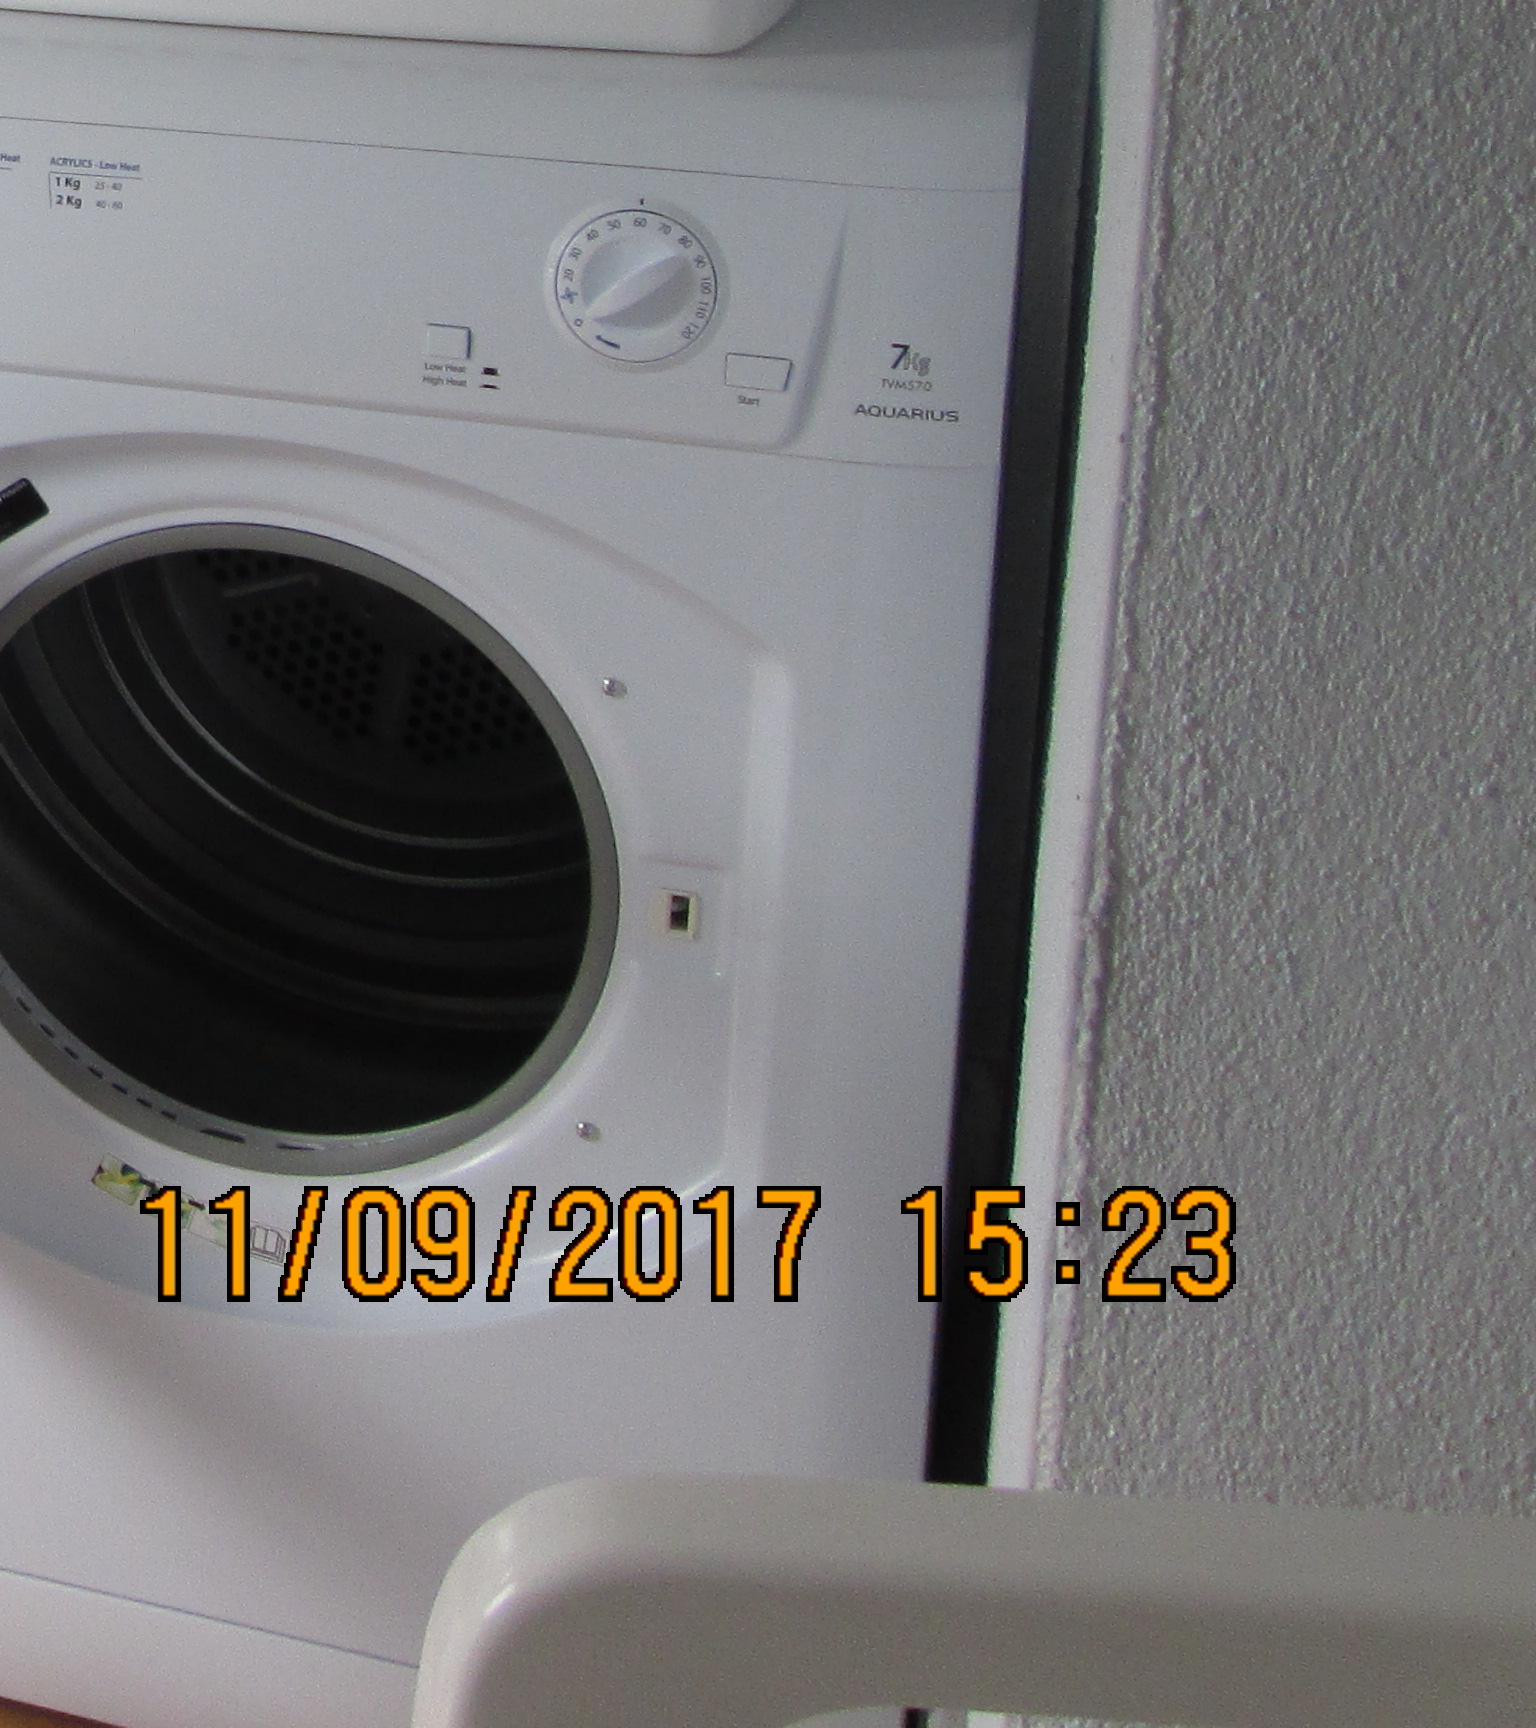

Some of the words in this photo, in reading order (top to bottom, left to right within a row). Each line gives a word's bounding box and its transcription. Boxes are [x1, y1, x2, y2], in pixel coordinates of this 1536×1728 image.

[0, 153, 21, 162] Heat
[50, 156, 93, 168] ACRYLICS
[120, 162, 140, 172] Heat
[55, 177, 61, 186] 1
[65, 177, 81, 190] Kg
[55, 195, 64, 205] 2
[66, 195, 82, 209] Kg
[633, 217, 648, 228] 60
[657, 222, 672, 235] 70
[586, 229, 599, 241] 40
[678, 235, 693, 249] 80
[568, 247, 582, 261] 30
[563, 268, 575, 282] 20
[700, 277, 713, 295] 100
[695, 301, 709, 319] 110
[681, 322, 700, 340] 120
[854, 404, 959, 423] AQUARIUS
